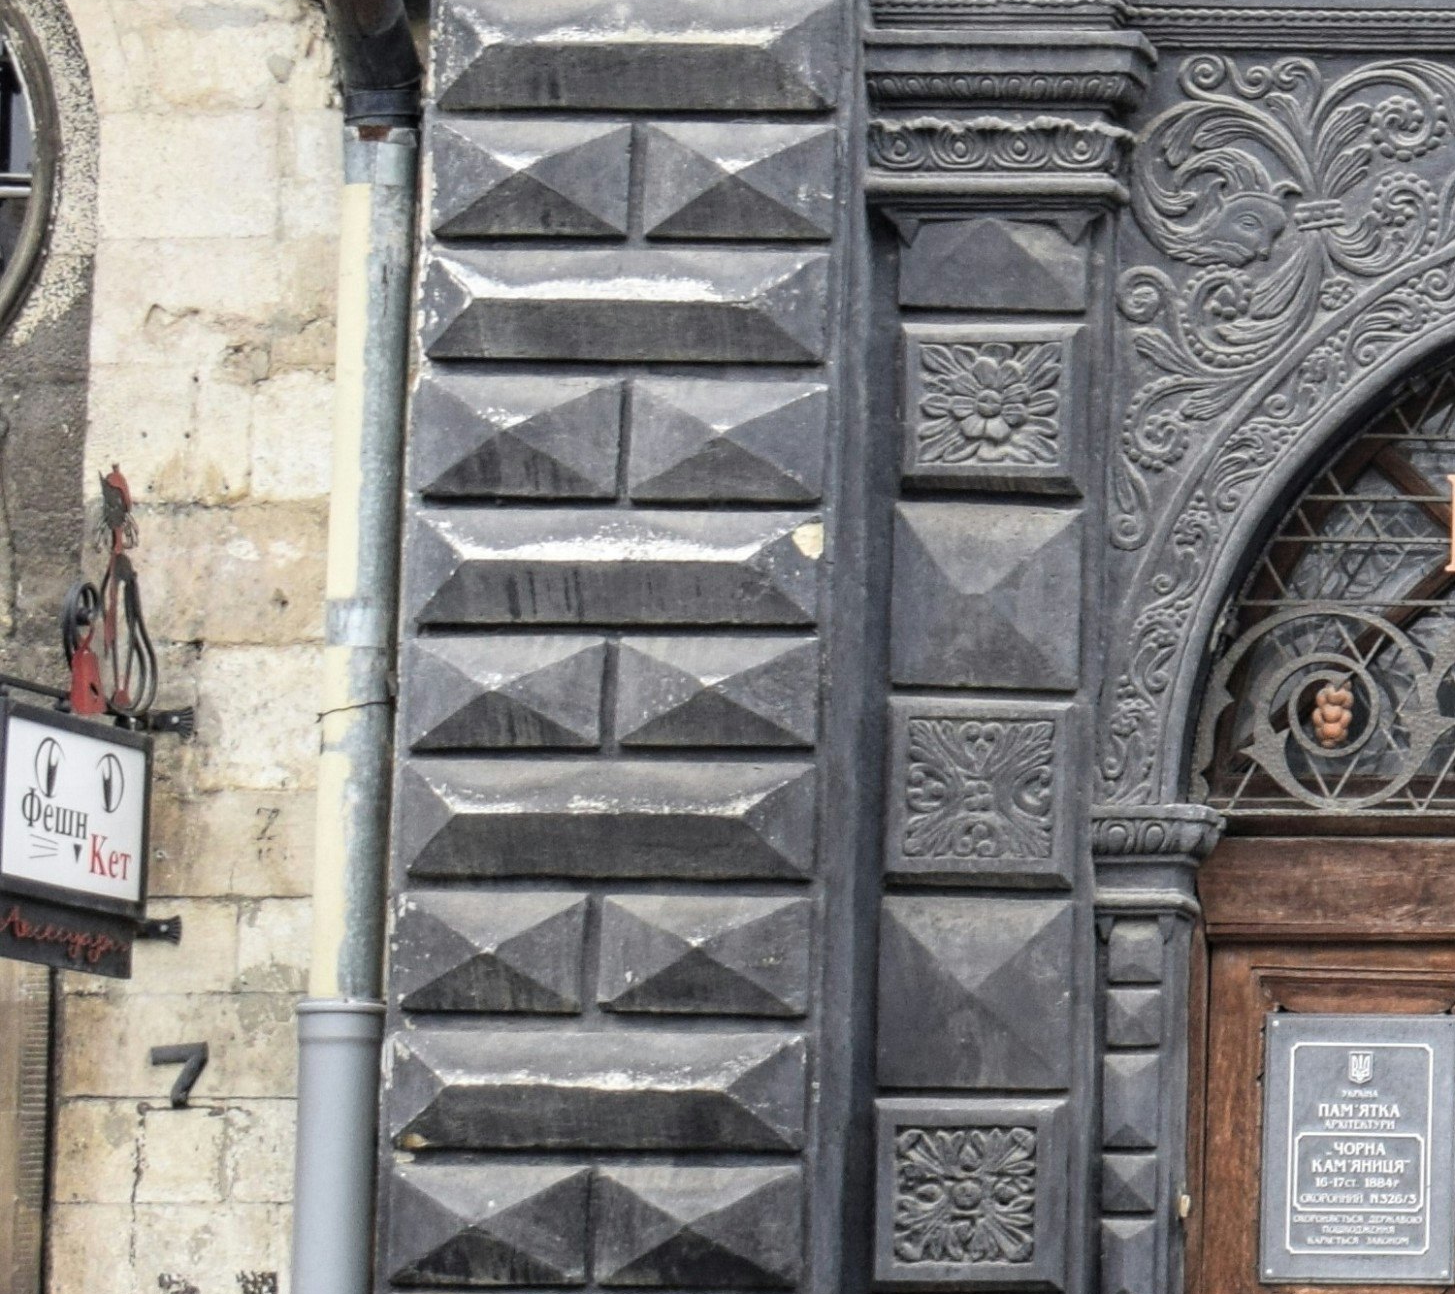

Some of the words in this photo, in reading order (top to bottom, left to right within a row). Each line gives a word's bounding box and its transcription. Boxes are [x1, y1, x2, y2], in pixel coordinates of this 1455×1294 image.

[21, 785, 89, 841] Фешн
[88, 833, 132, 882] Кет
[1324, 1119, 1396, 1130] АРХІТЕКТУРИ
